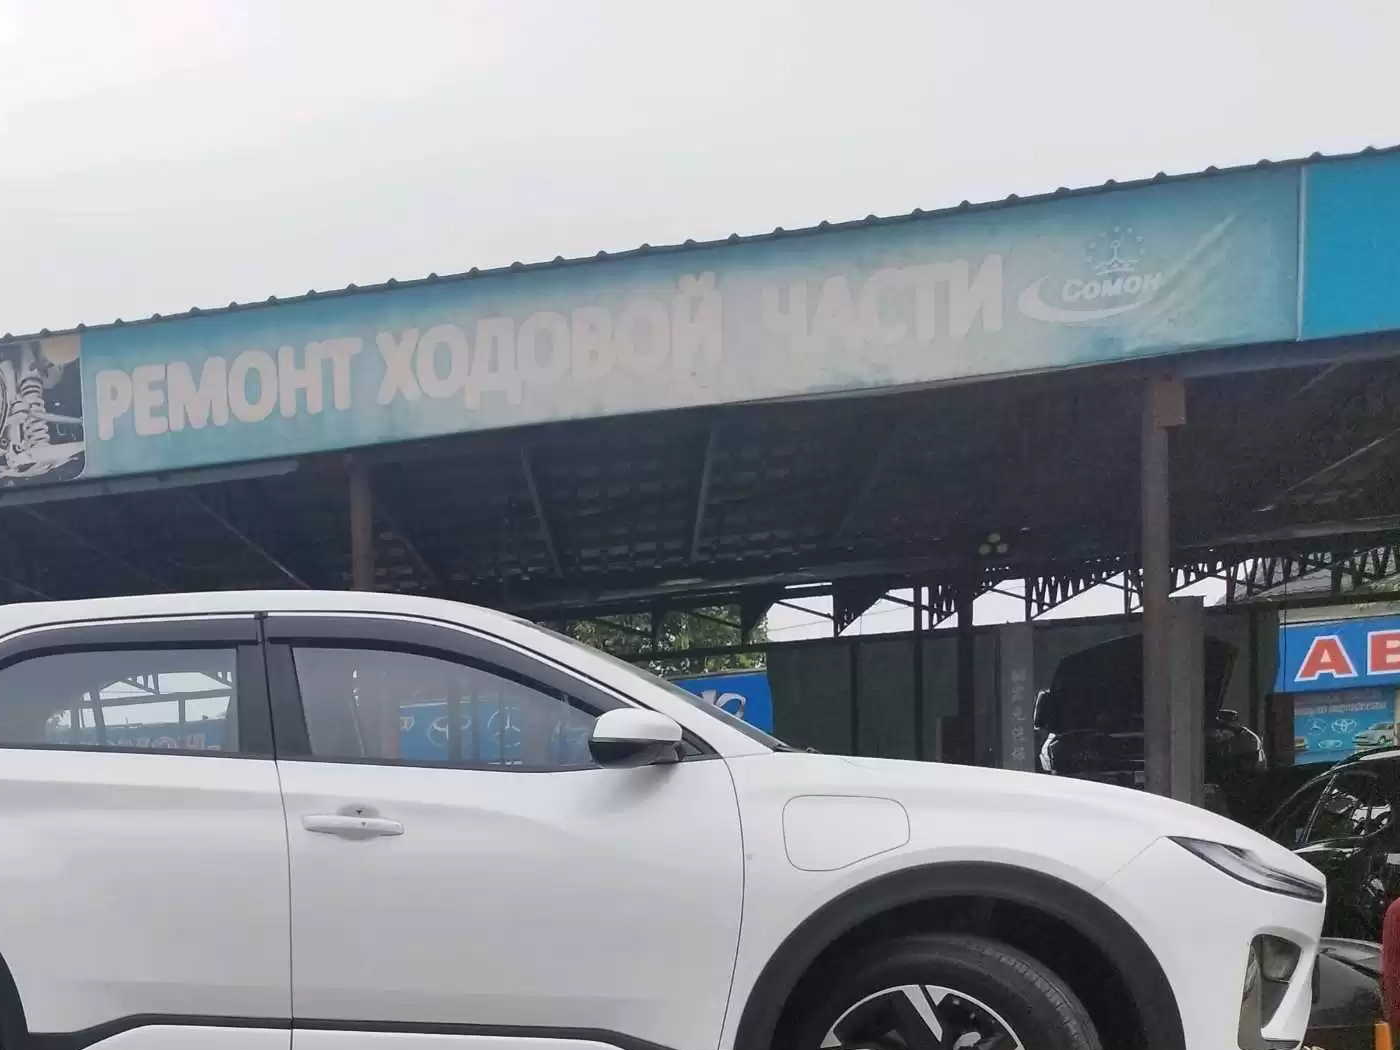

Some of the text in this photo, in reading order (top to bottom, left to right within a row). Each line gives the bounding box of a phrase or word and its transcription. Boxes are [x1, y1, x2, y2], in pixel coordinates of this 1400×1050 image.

[95, 254, 1003, 441] РЕМОНТ ХОДОВОЙ ЧАСТИ
